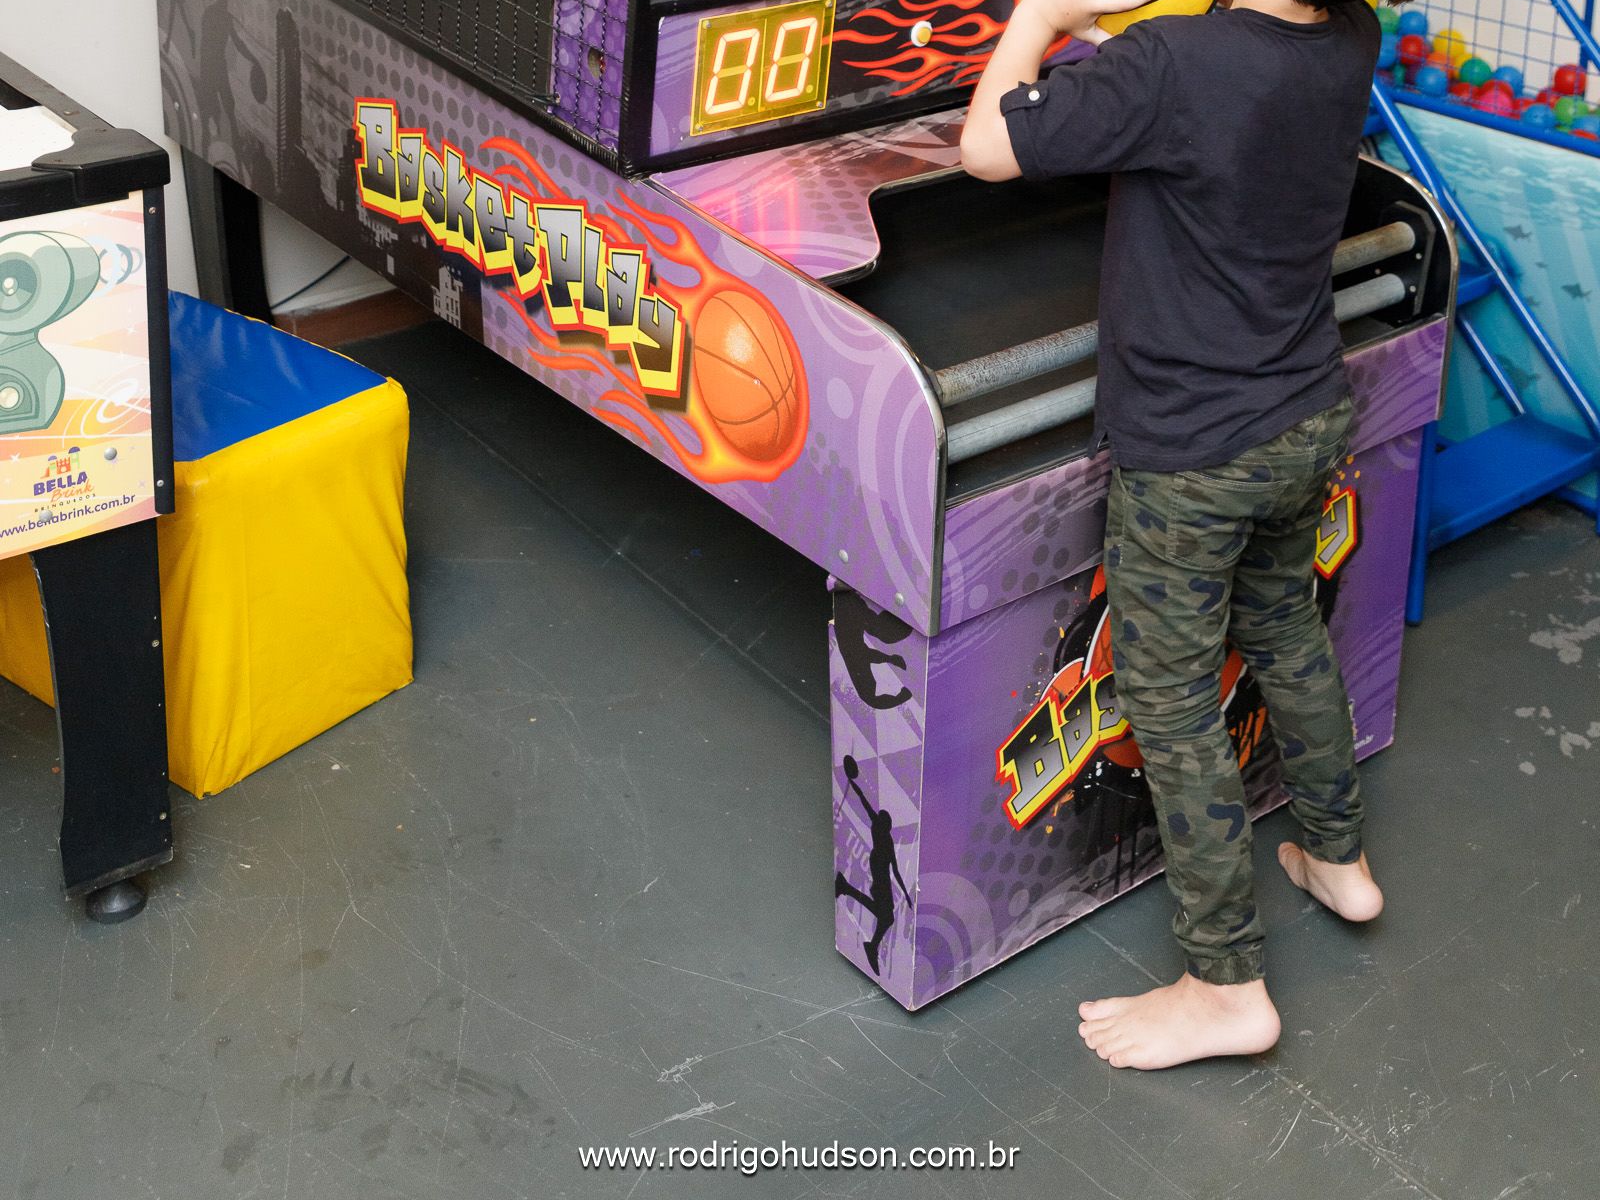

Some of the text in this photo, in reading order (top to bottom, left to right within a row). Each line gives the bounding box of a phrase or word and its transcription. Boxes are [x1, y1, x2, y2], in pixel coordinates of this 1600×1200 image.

[33, 471, 88, 496] BELLA
[50, 480, 95, 503] Brink
[0, 494, 136, 538] ww.beabrink.com.br
